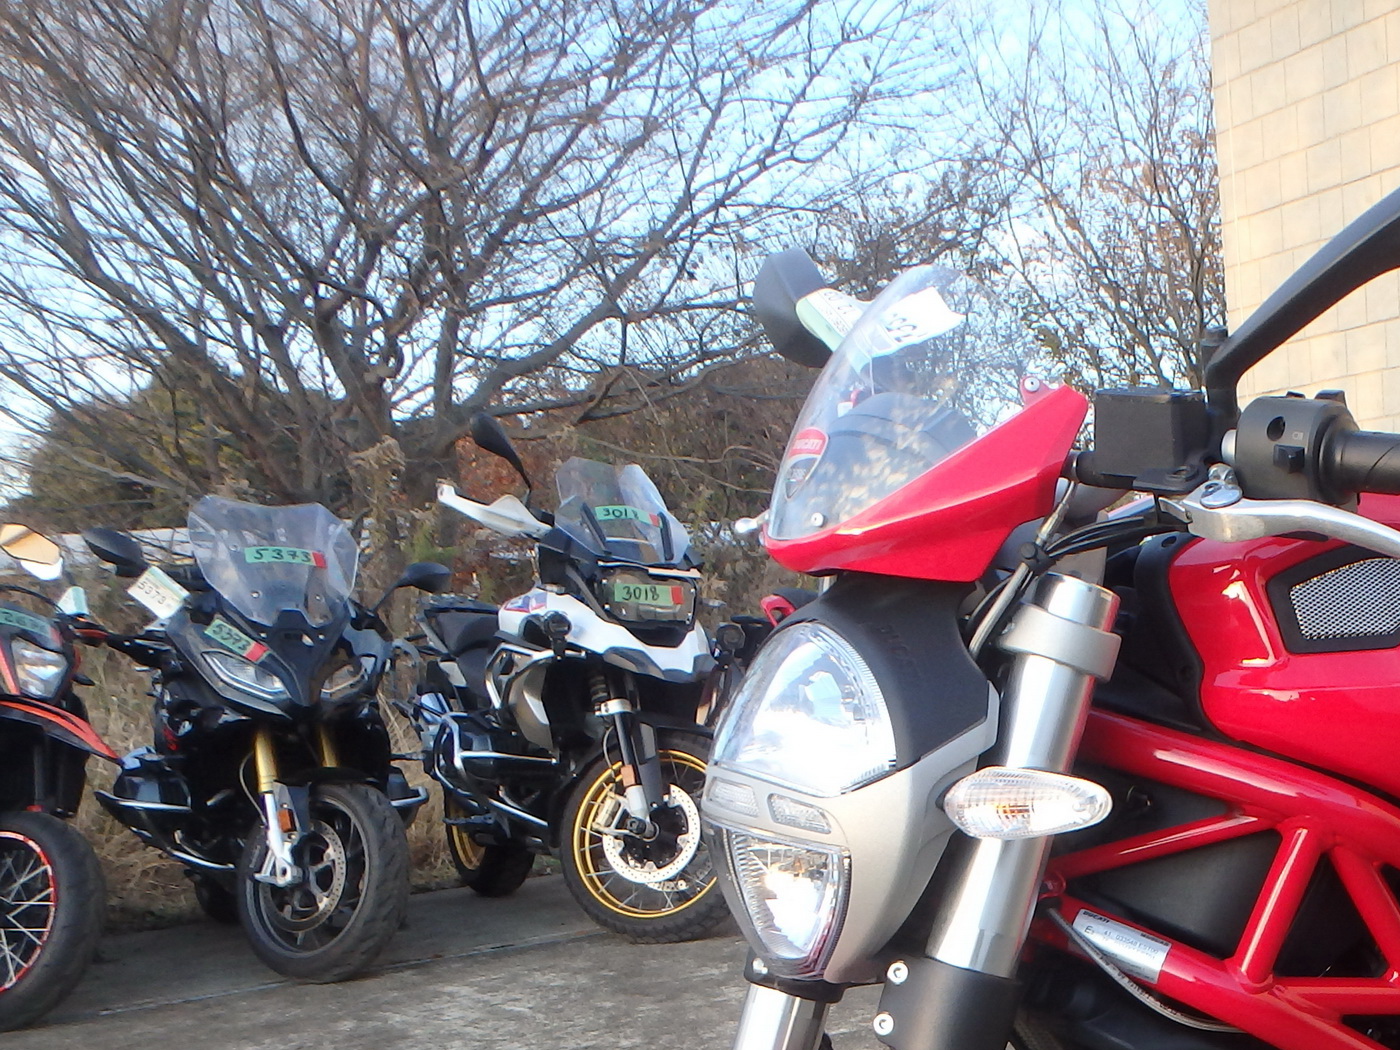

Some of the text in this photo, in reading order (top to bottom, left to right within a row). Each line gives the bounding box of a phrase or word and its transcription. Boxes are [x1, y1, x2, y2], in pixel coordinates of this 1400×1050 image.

[253, 549, 312, 563] 5373
[137, 580, 167, 605] 5373
[621, 585, 660, 601] 3018
